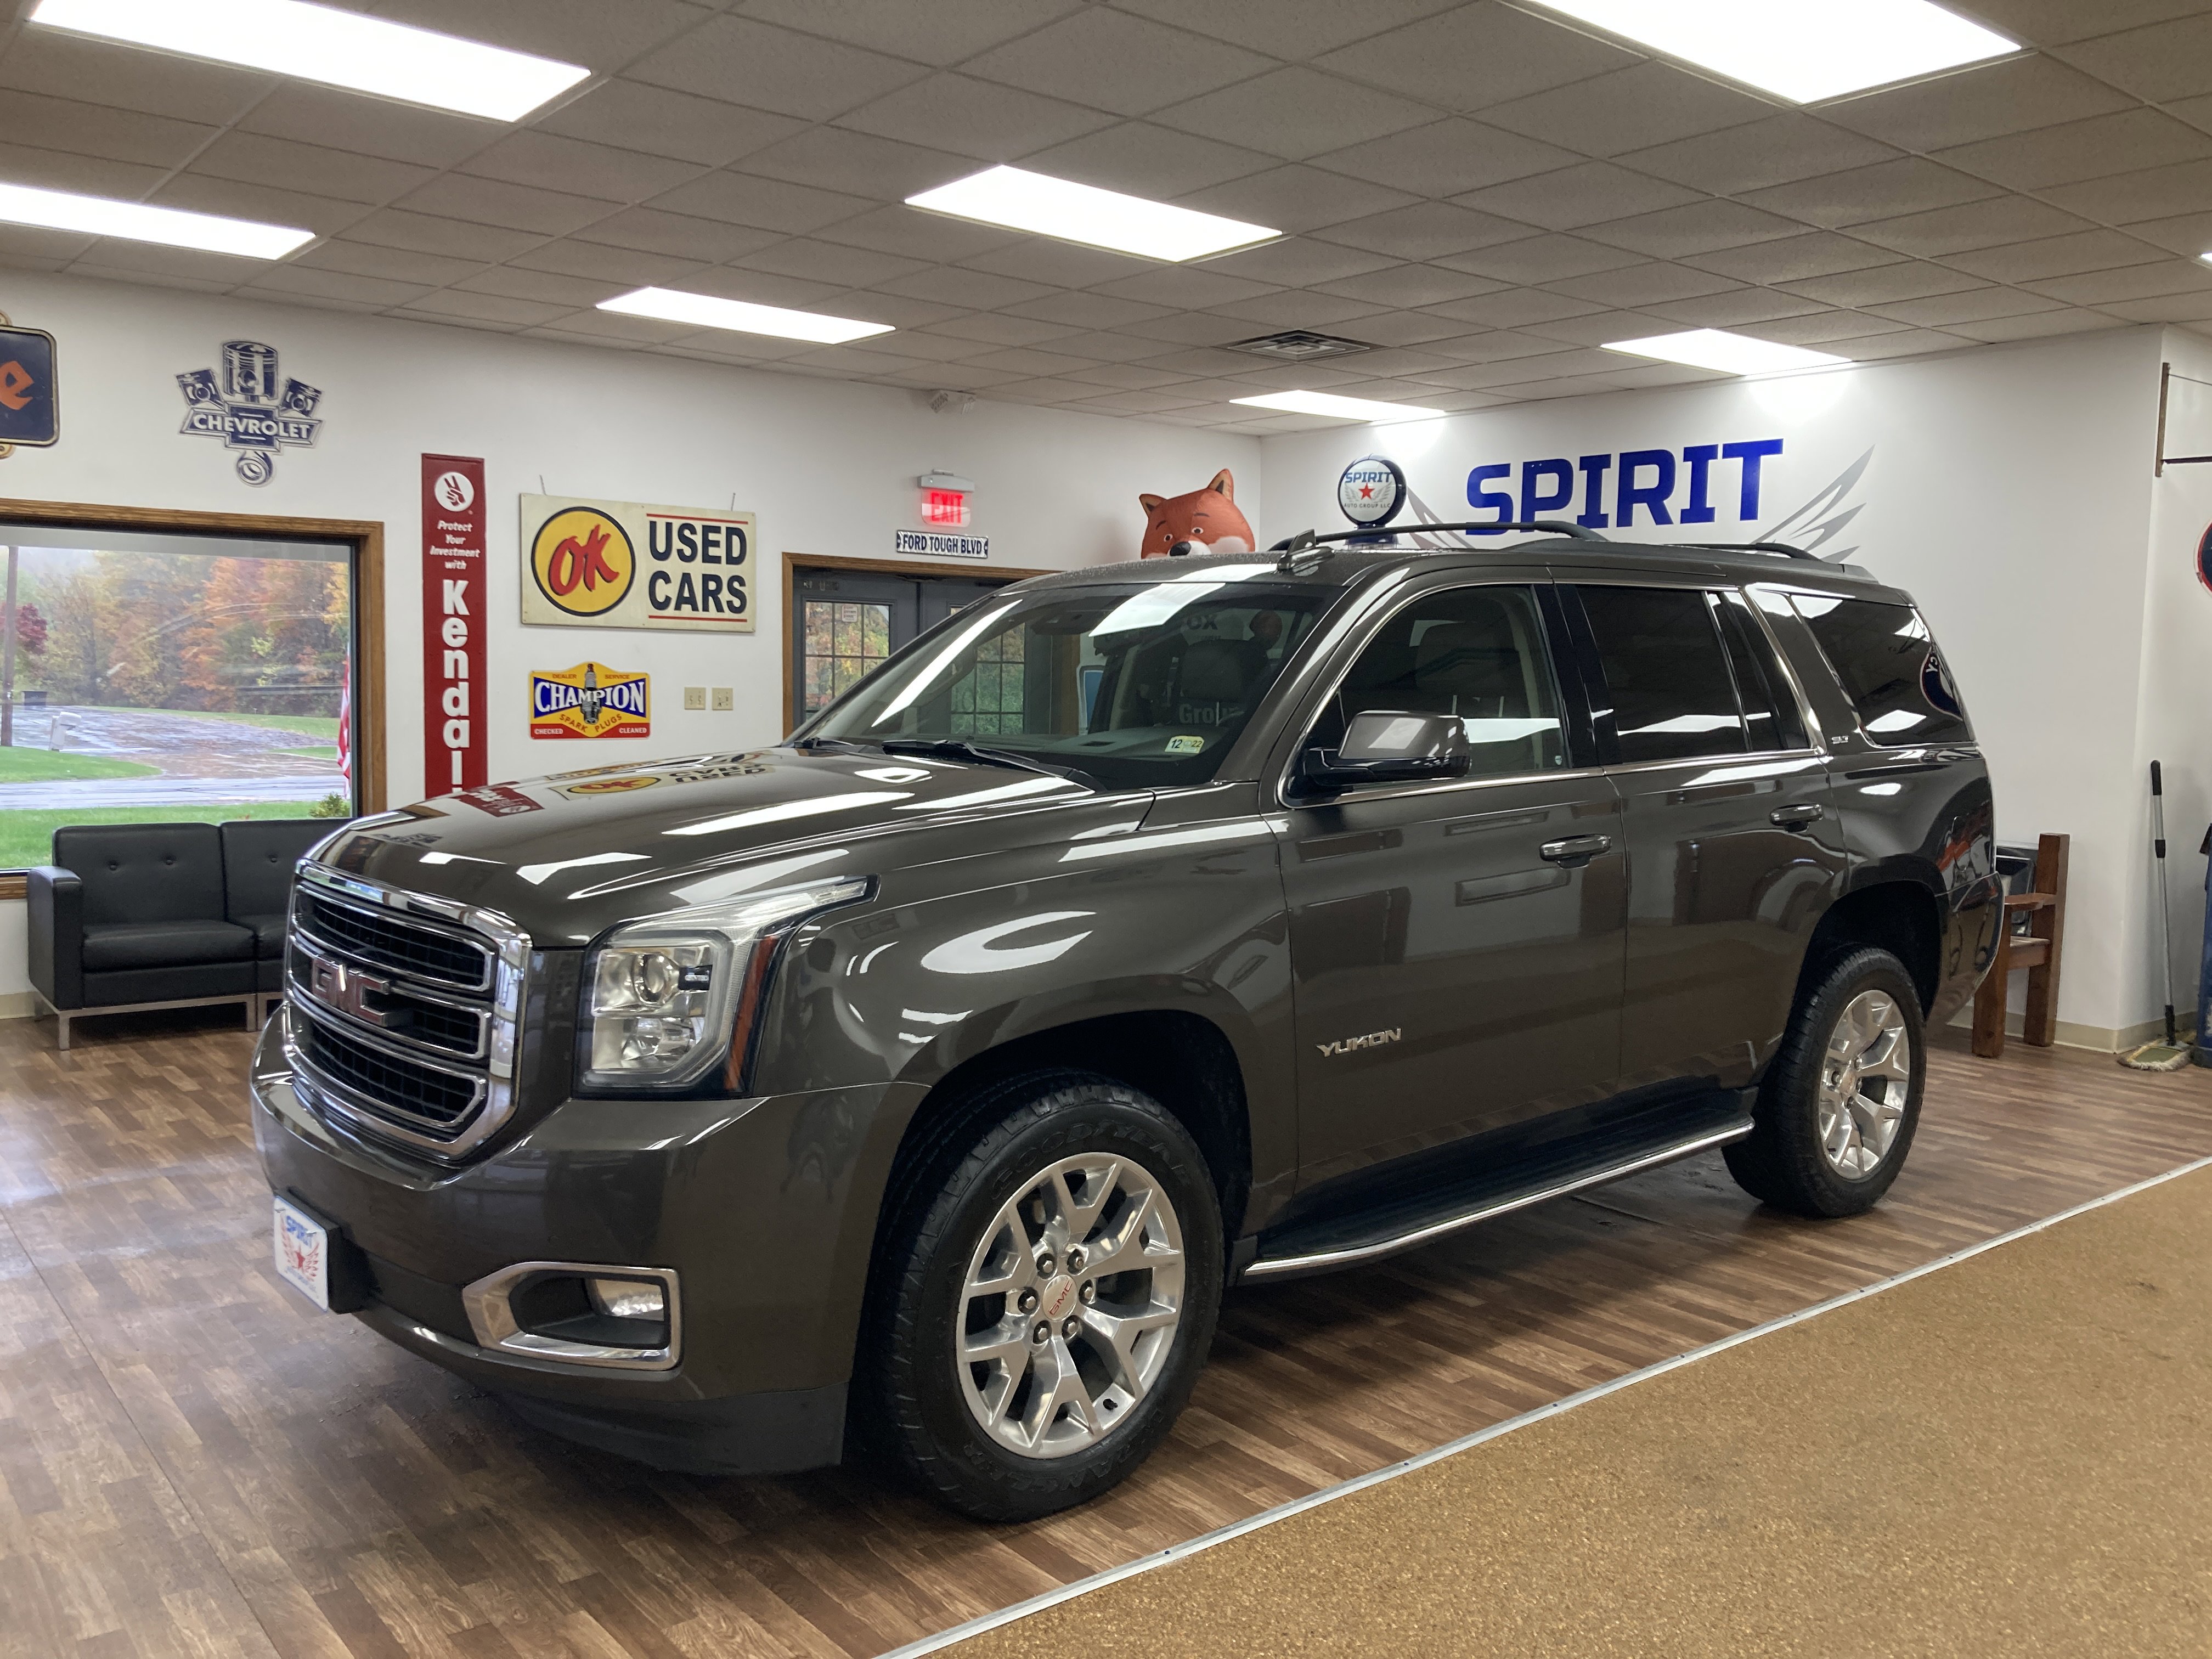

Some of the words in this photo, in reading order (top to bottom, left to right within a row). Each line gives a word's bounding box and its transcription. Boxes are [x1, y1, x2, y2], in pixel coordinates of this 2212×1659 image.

[193, 413, 311, 439] CHEVROLET
[1344, 472, 1392, 483] SPIRIT
[1465, 438, 1784, 535] SPIRIT
[931, 492, 963, 524] EXIT
[437, 520, 473, 532] Protect
[445, 534, 466, 545] Your
[430, 545, 481, 557] Investment
[649, 521, 747, 566] USED
[902, 534, 927, 550] FORD
[930, 536, 958, 553] TOUGH
[961, 539, 982, 554] BLVD
[444, 560, 466, 569] with
[549, 523, 620, 596] OK
[648, 571, 747, 614] CARS
[442, 579, 470, 792] Kendal
[534, 682, 645, 713] CHAMPION
[559, 713, 588, 733] SPARK
[595, 713, 623, 733] PLUGS
[1171, 739, 1183, 749] 12
[311, 956, 390, 1027] GMC
[1316, 1028, 1402, 1057] YUKON
[1049, 1279, 1073, 1315] GMC
